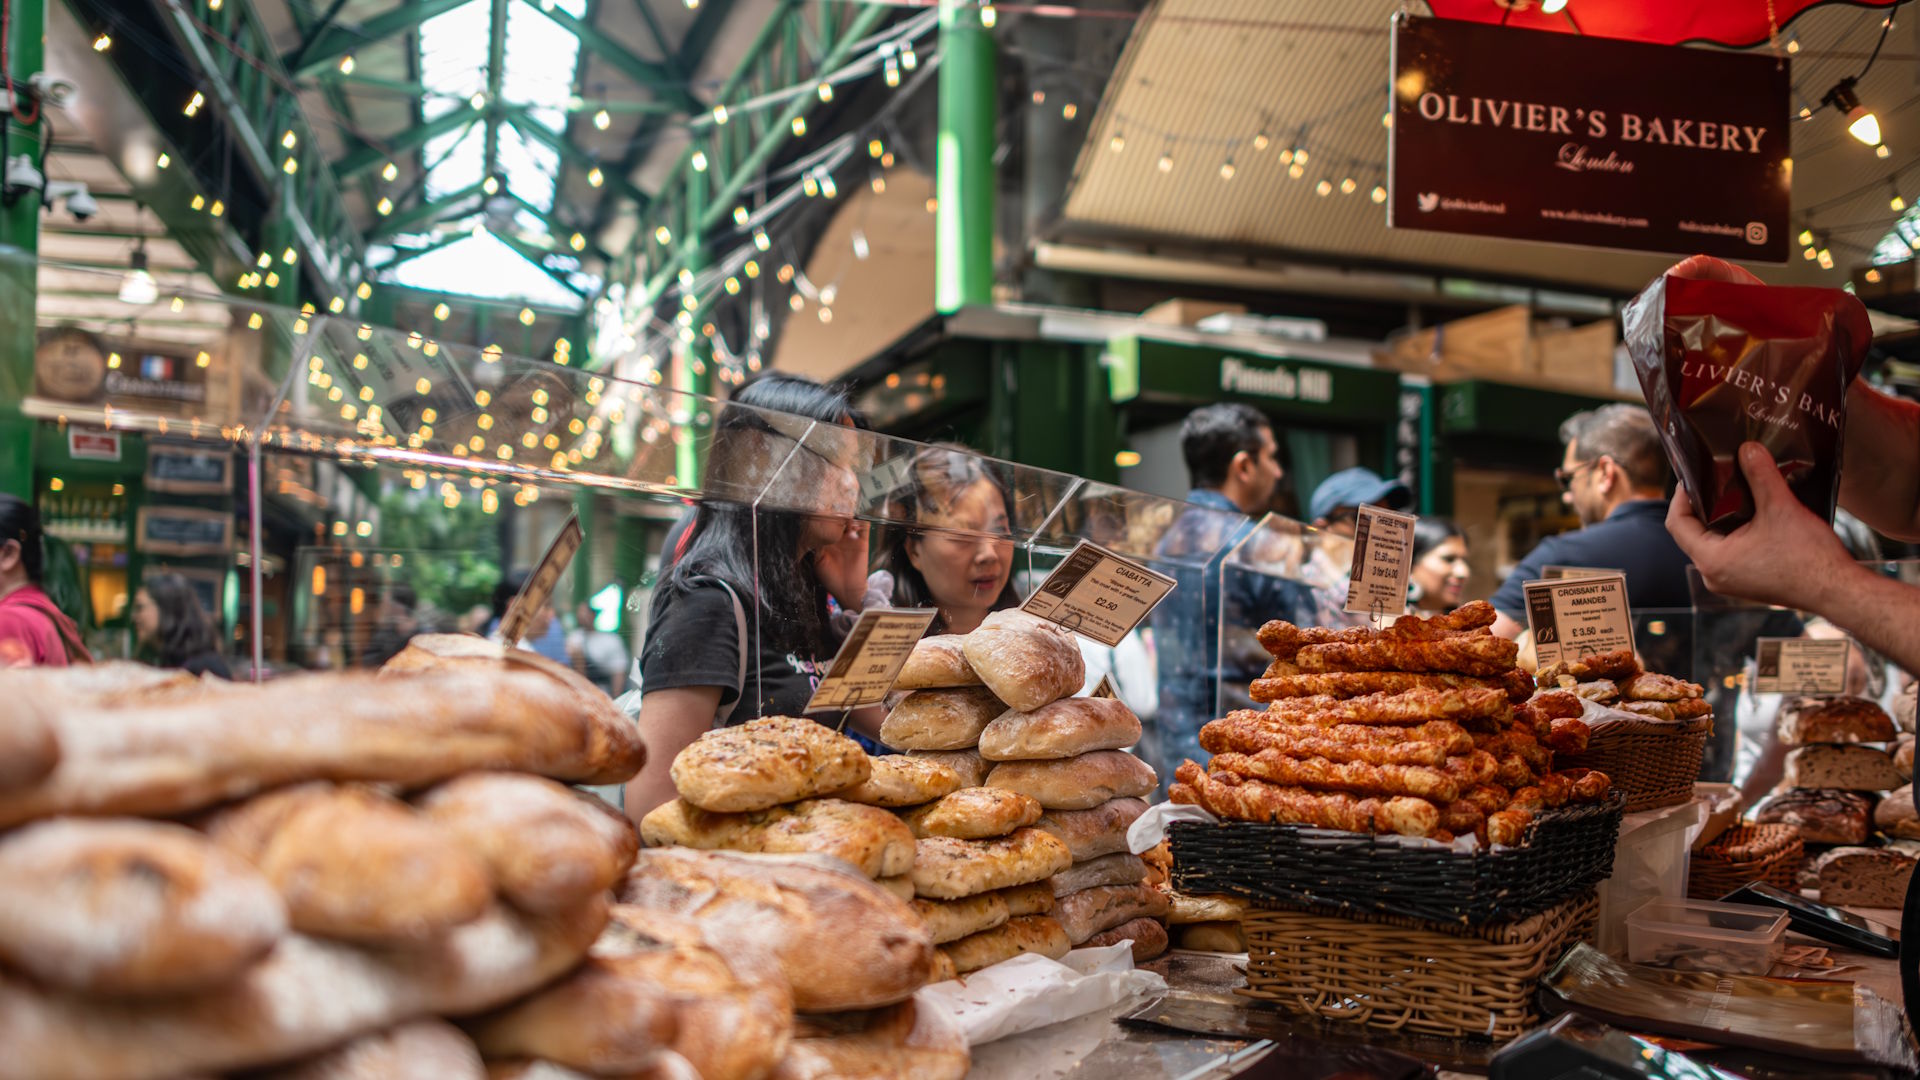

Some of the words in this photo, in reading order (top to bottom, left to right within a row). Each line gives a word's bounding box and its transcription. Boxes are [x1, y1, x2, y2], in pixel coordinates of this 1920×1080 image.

[1418, 92, 1607, 138] OLIVIER'S
[1621, 113, 1768, 154] BAKERY
[1555, 142, 1634, 173] London
[1220, 356, 1297, 400] Pimento
[1298, 366, 1333, 403] Hill
[1680, 360, 1791, 405] LIVIER'S
[1798, 391, 1842, 430] BAK
[1746, 401, 1800, 431] London
[1115, 567, 1153, 588] CIABATTA
[1377, 567, 1385, 577] for
[1558, 586, 1599, 597] CROISSANT
[1601, 584, 1616, 593] AUX
[1571, 596, 1607, 606] AMANDES
[1094, 597, 1118, 611] £2.50
[1572, 628, 1578, 637] £
[1579, 626, 1596, 637] 3.50
